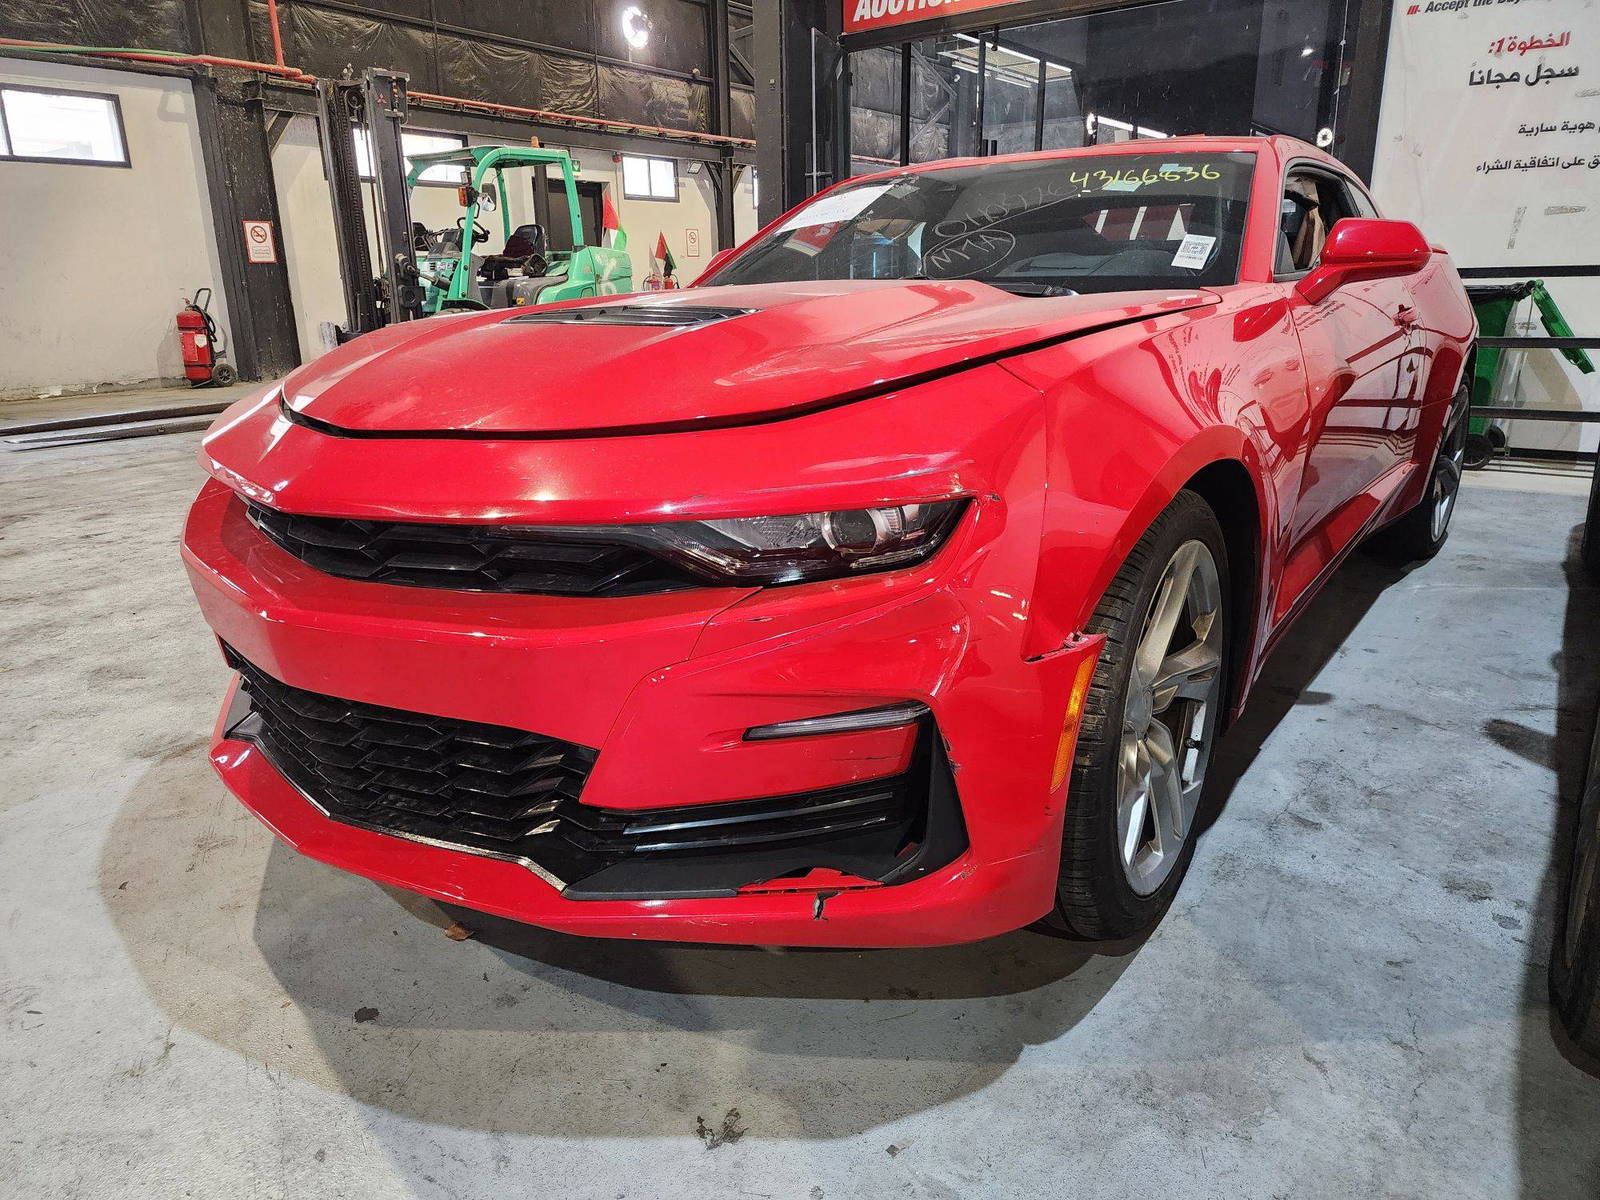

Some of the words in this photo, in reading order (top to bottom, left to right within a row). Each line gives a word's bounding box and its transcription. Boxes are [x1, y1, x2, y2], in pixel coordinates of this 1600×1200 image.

[1425, 0, 1470, 13] Accept
[1507, 31, 1572, 56] الخطوة
[1525, 63, 1580, 87] سجل
[1517, 122, 1558, 137] سارية
[1560, 120, 1596, 134] هوية
[1475, 159, 1513, 175] الشراء
[1513, 155, 1560, 172] اتفاقية
[1561, 156, 1586, 170] على
